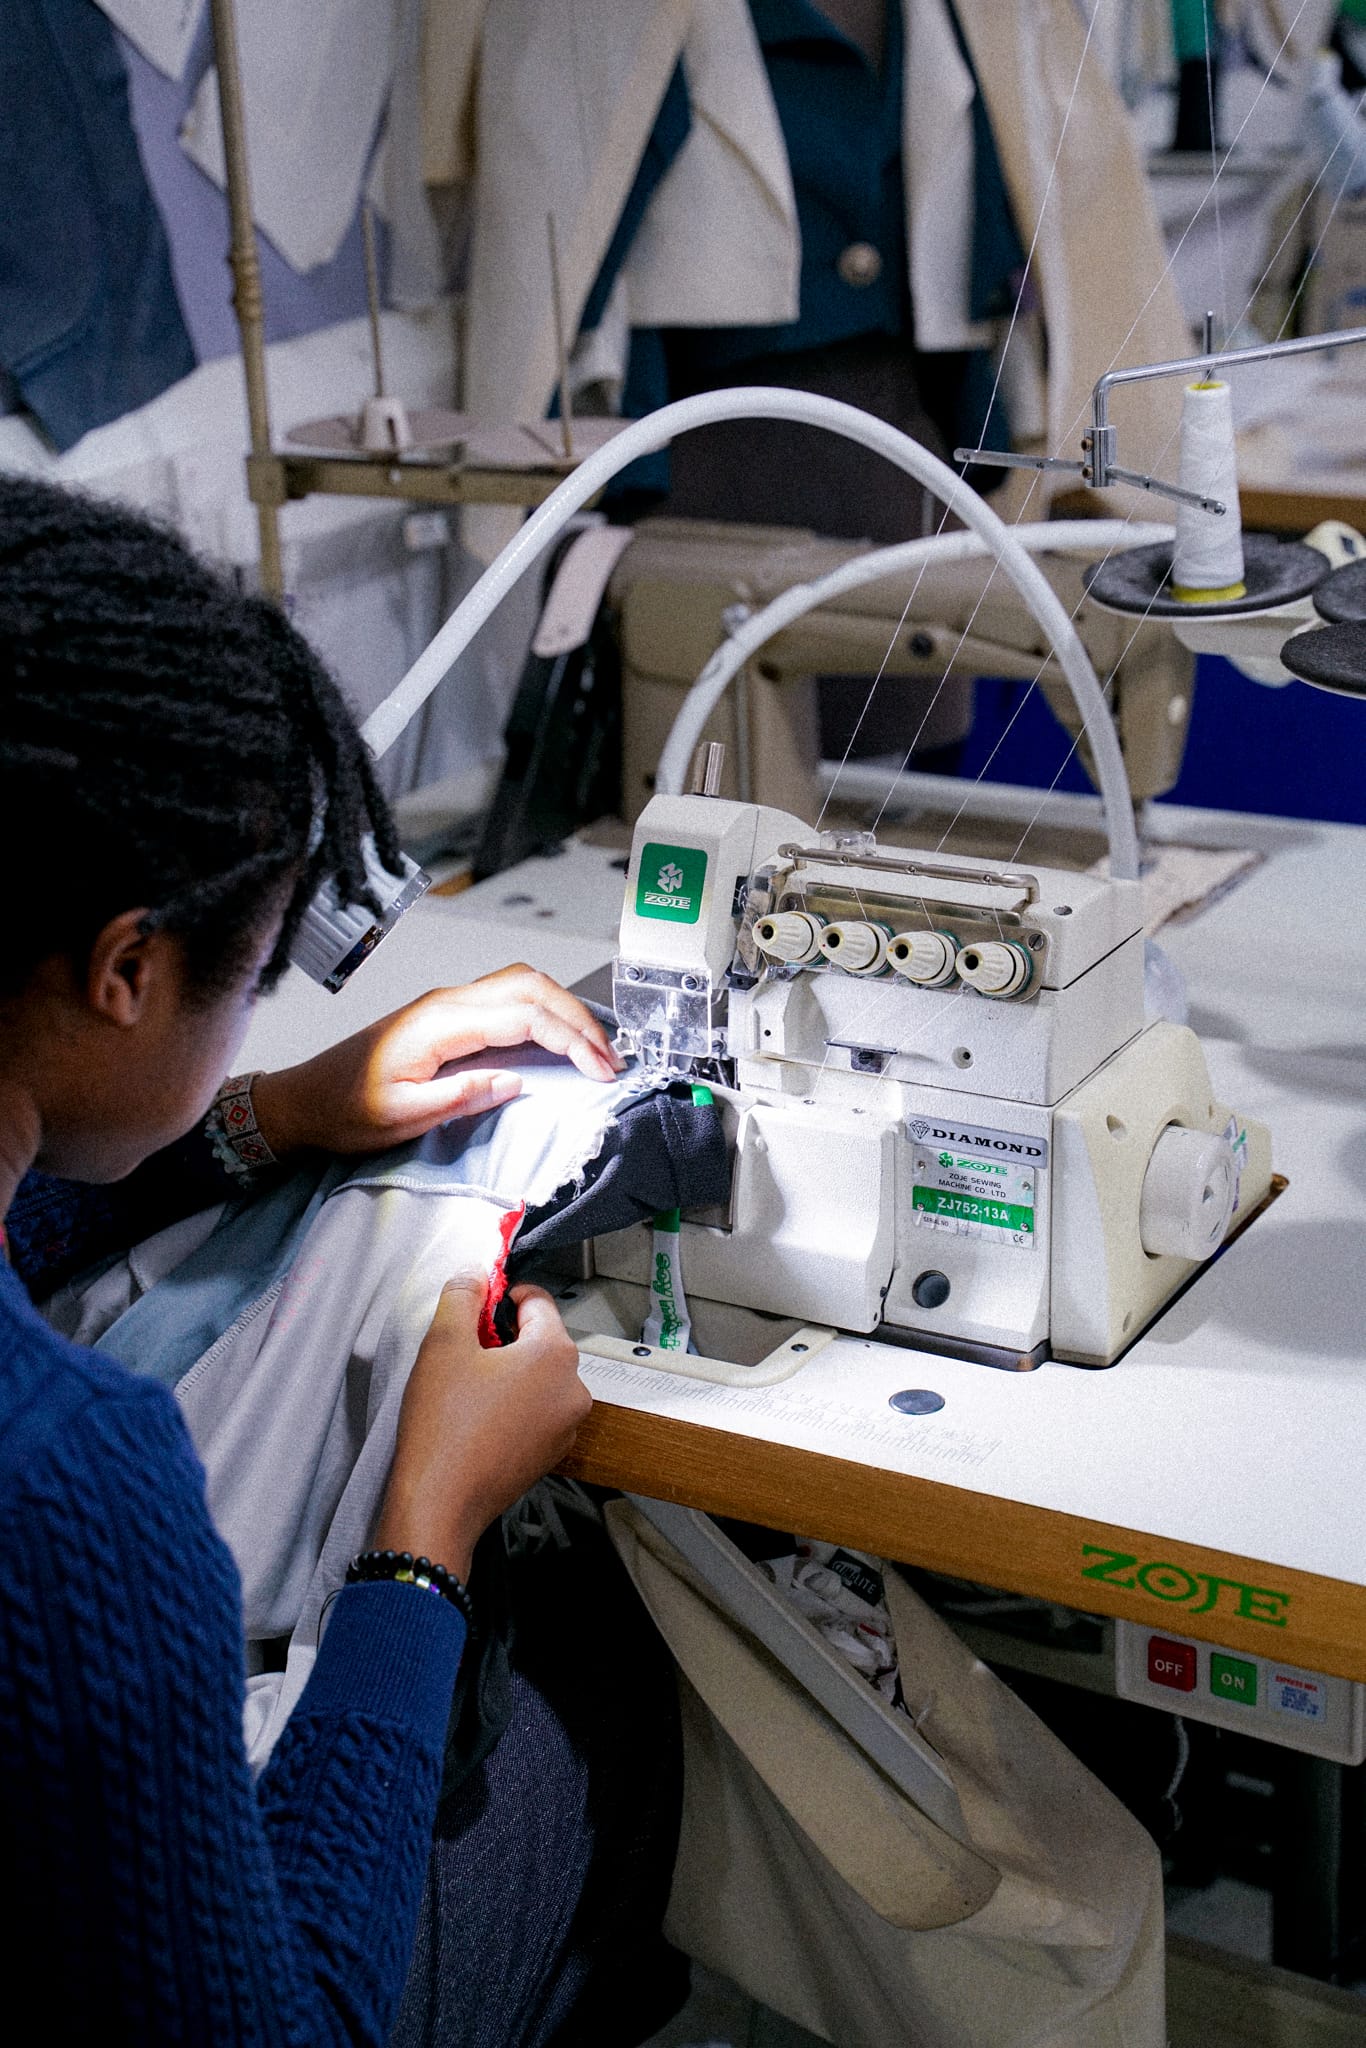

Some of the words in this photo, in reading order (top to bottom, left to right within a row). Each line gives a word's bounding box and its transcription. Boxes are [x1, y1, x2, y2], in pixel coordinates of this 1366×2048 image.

[644, 892, 691, 910] ZOJE
[932, 1128, 1042, 1157] DIAMOND
[956, 1158, 1008, 1175] ZOJE
[938, 1178, 972, 1192] MACHINE
[949, 1172, 968, 1182] ZOJE
[970, 1177, 1002, 1189] SEWING
[937, 1197, 1009, 1221] ZJ752-13A
[1013, 1234, 1024, 1244] CE
[1081, 1543, 1291, 1628] ZOJE
[1154, 1658, 1184, 1677] OFF
[1220, 1672, 1246, 1690] ON
